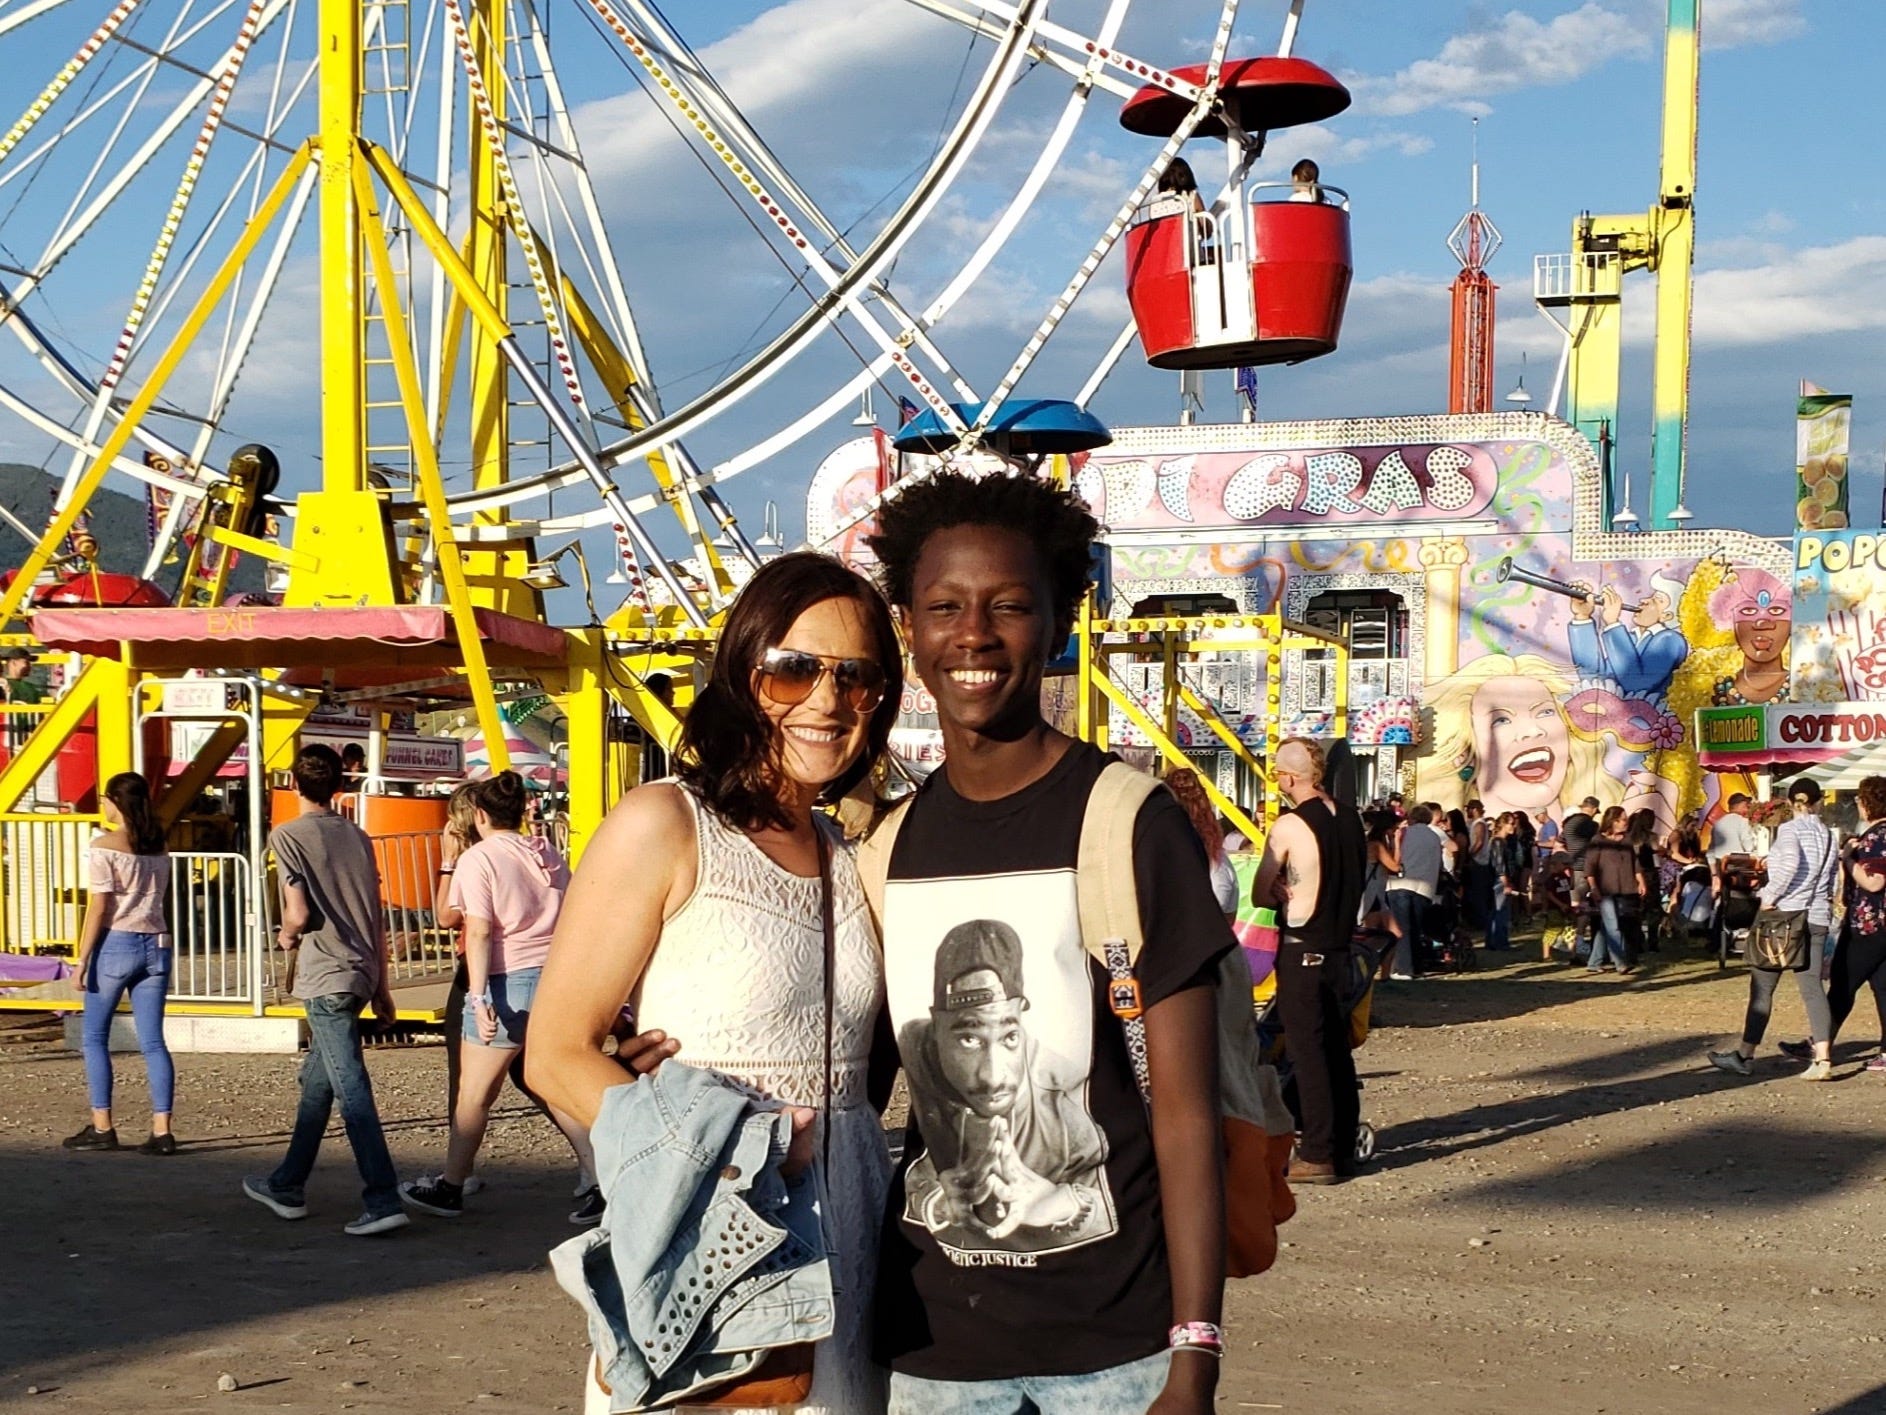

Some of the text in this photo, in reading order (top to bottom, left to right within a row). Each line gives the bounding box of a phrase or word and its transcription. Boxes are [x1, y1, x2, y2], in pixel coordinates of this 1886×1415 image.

[1223, 446, 1475, 522] GRAS
[207, 612, 257, 633] EXIT
[1709, 714, 1759, 743] Lemonade
[981, 1253, 1038, 1267] JUSTICE
